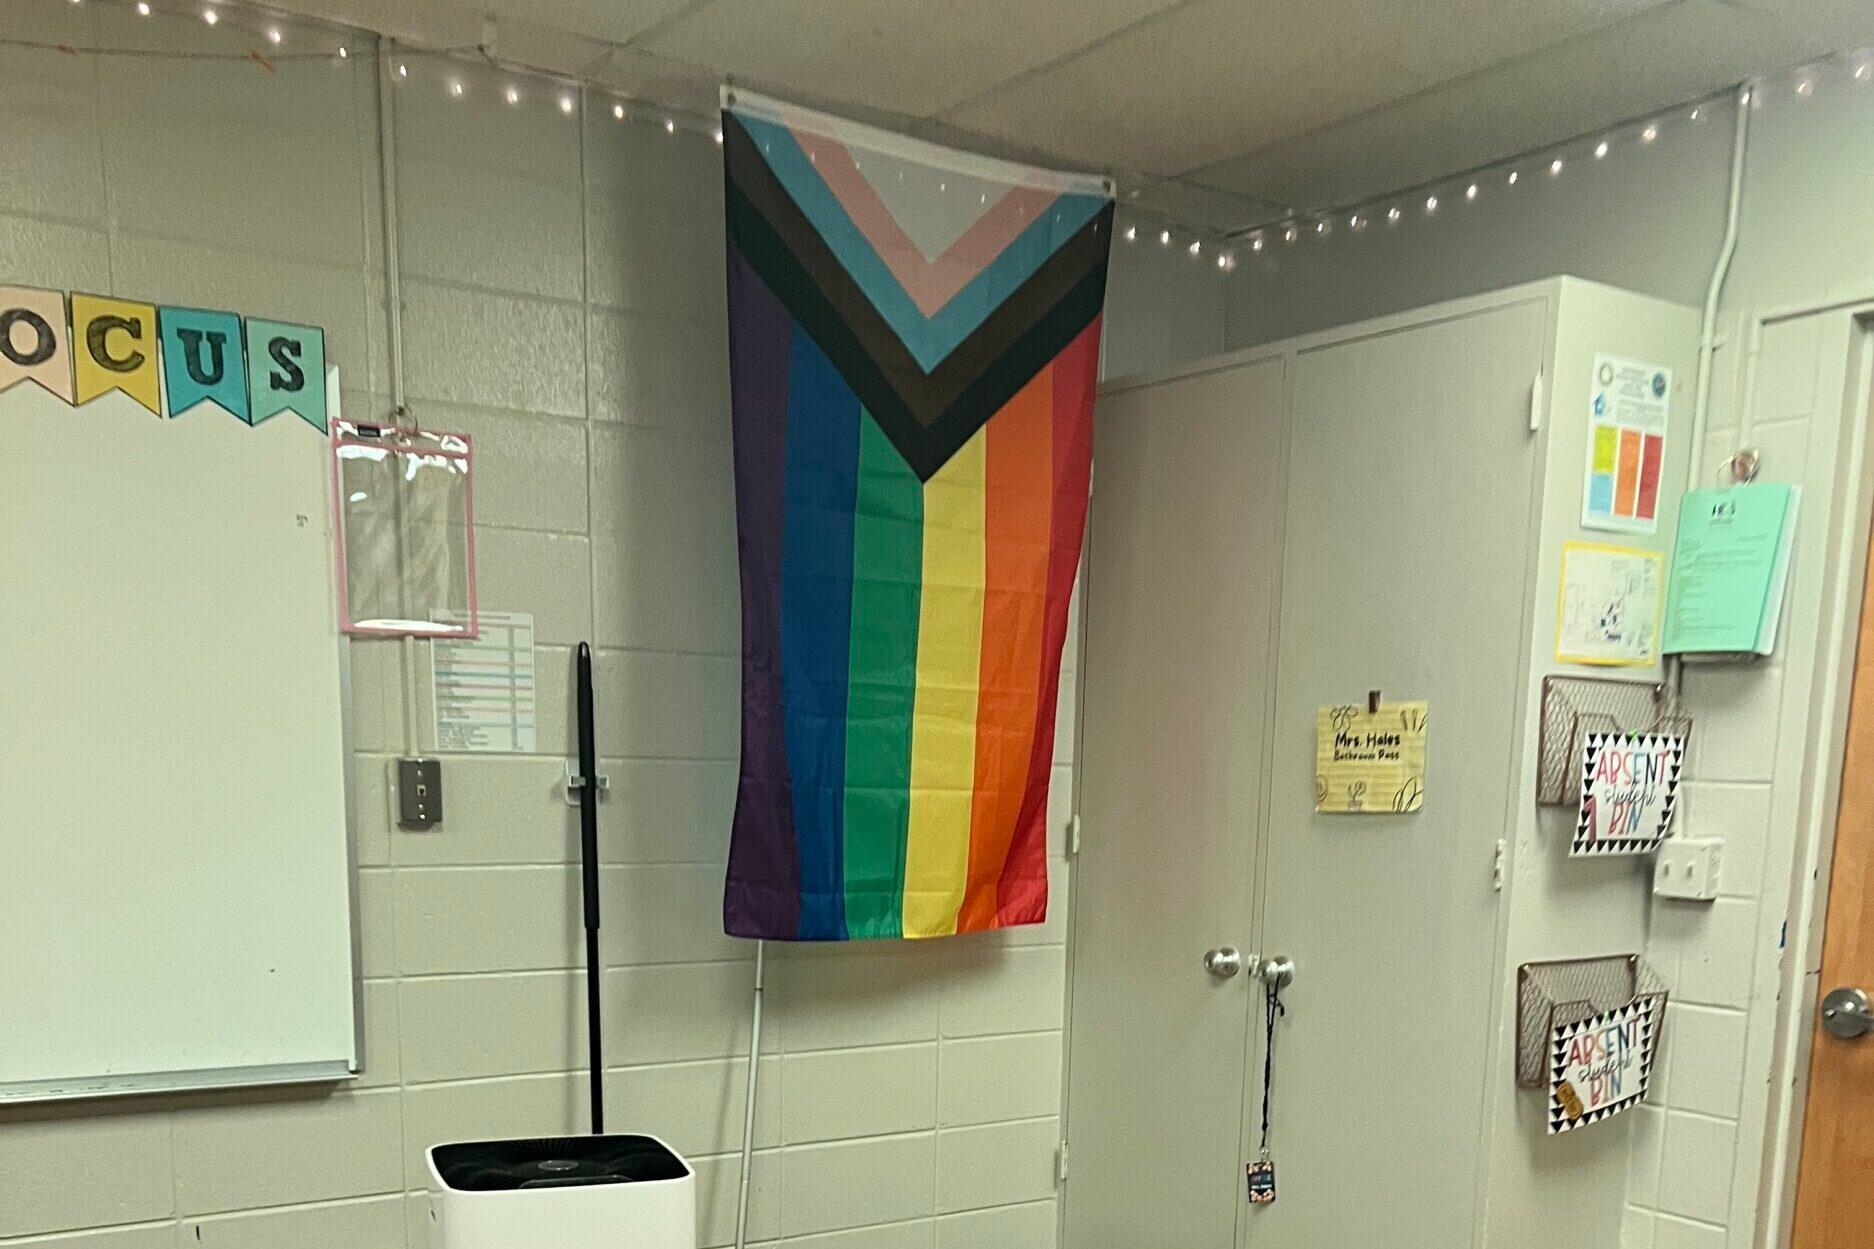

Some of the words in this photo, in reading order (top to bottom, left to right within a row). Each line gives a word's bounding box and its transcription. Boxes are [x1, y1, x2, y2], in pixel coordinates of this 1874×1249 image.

[1378, 748, 1400, 760] Pass
[1597, 750, 1671, 785] ABSENT
[1608, 800, 1644, 836] BIN
[1568, 1019, 1640, 1068] ABSENT
[1590, 1067, 1622, 1107] BIN
